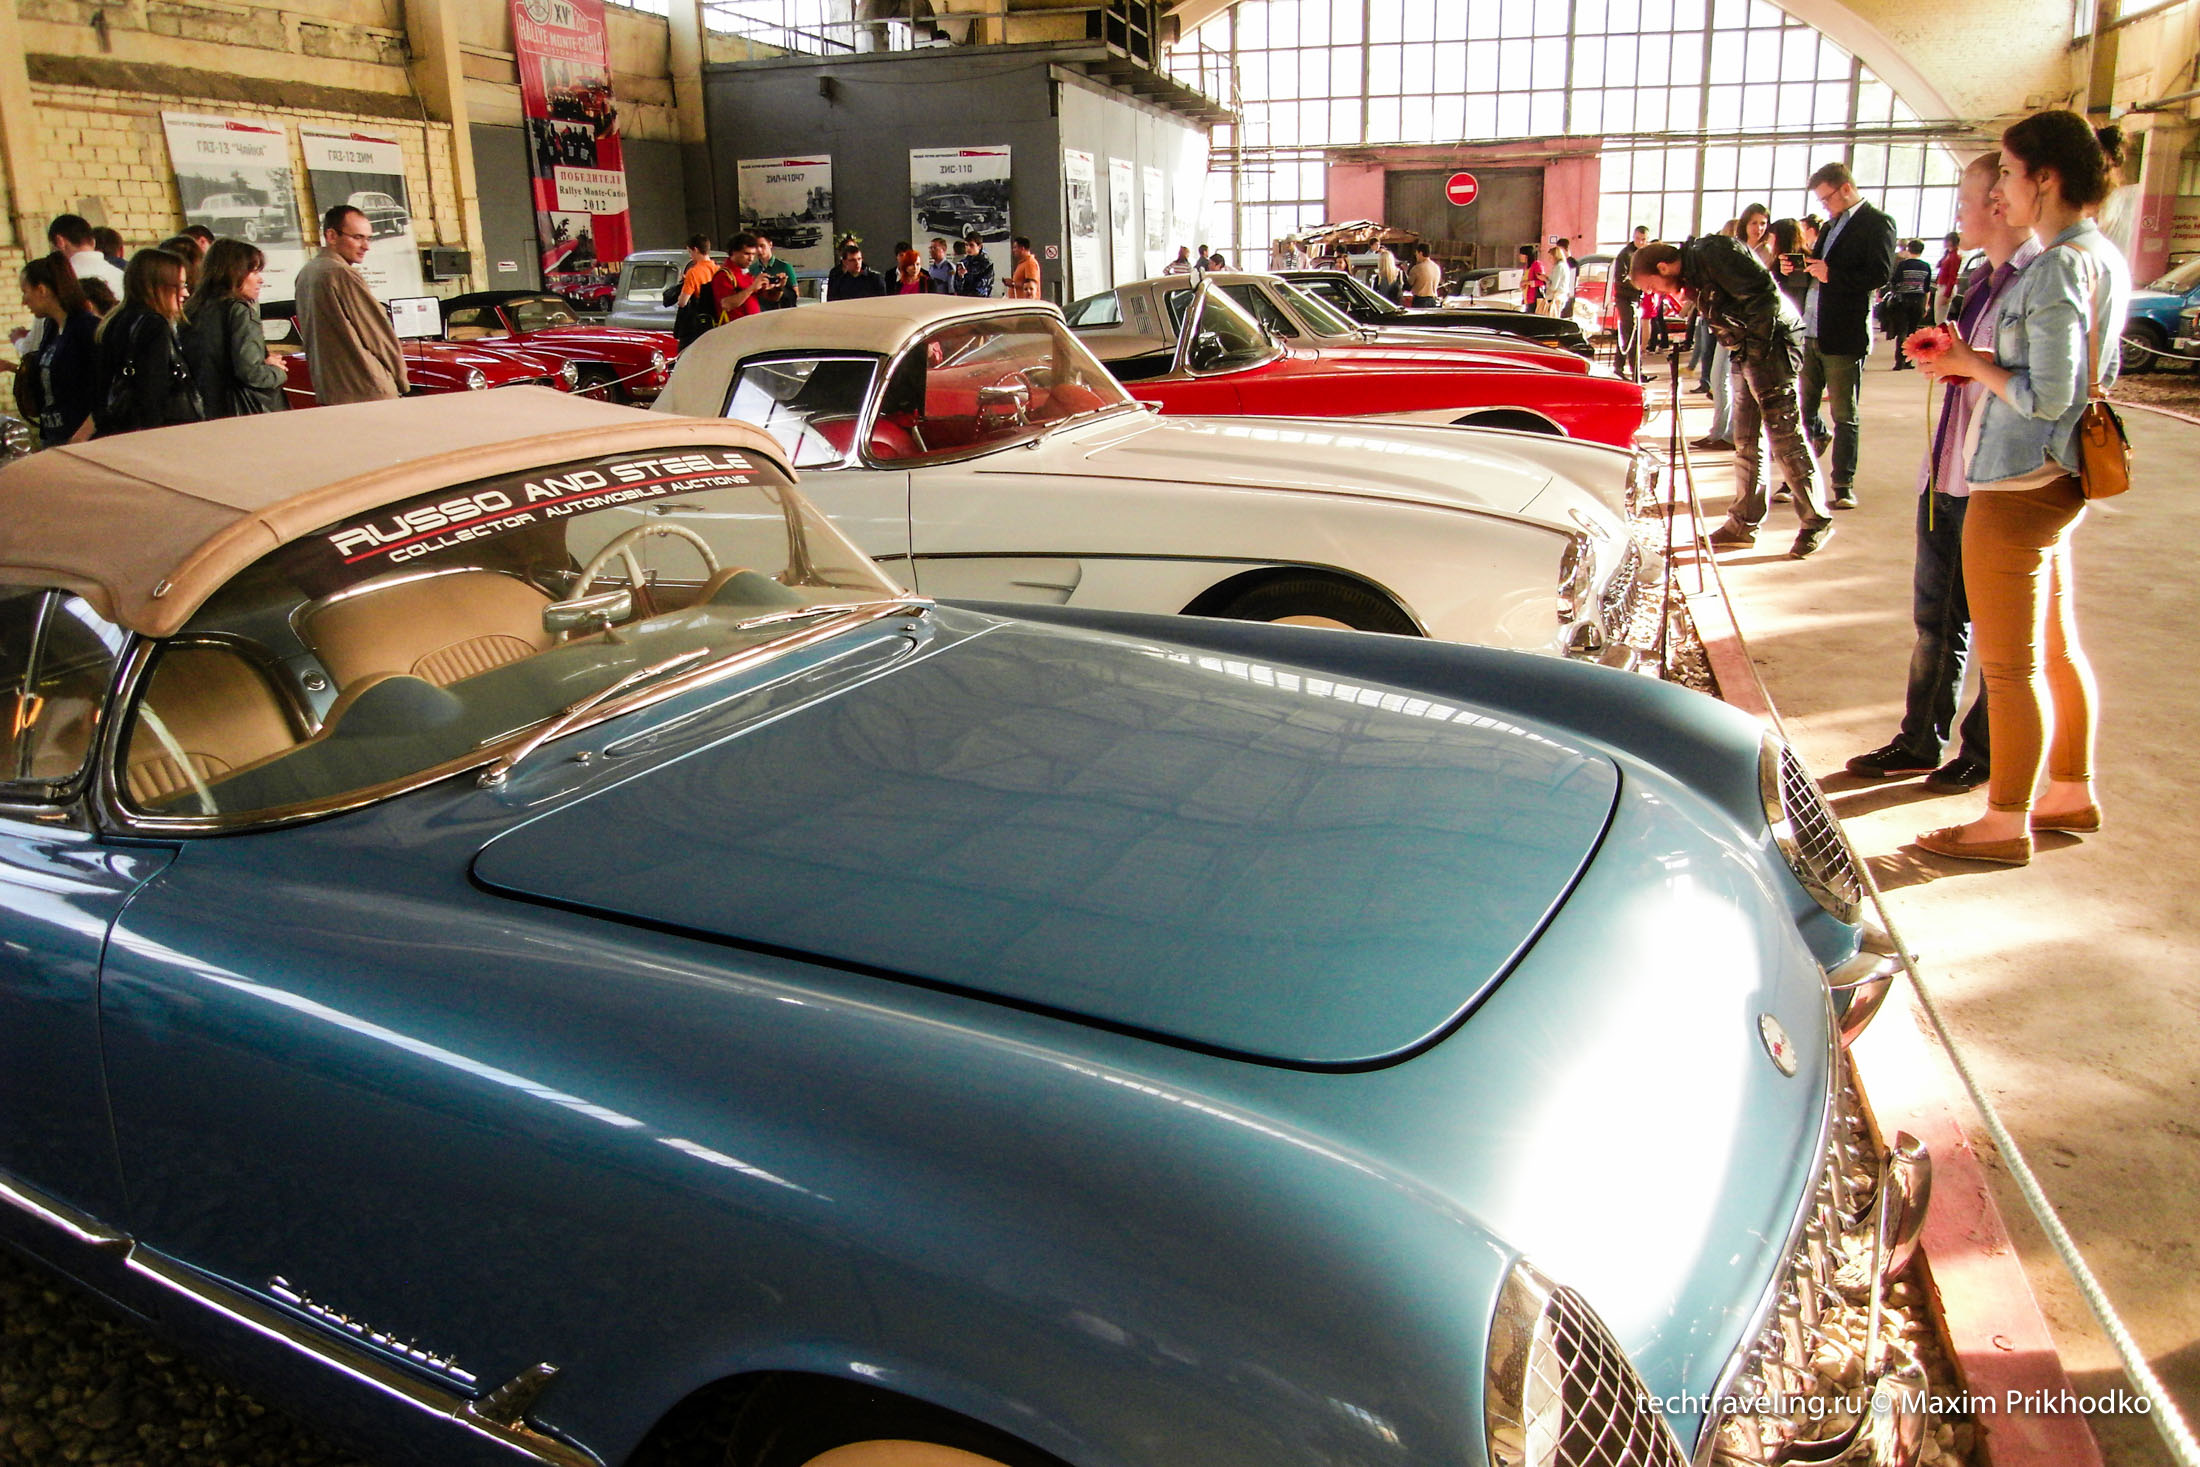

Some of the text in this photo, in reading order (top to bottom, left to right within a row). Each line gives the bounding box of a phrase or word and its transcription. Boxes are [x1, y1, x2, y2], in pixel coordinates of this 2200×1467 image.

[518, 13, 548, 46] RALLYE
[196, 140, 229, 154] ГАЗ-13
[357, 152, 374, 164] ЗИМ
[939, 164, 973, 174] ЗИС-110
[559, 185, 582, 197] Rallye
[583, 199, 606, 211] 2012
[328, 453, 754, 557] RUSSO AND STEELE
[388, 474, 751, 564] COLLECTOR AUTOMOBILE AUCTIONS
